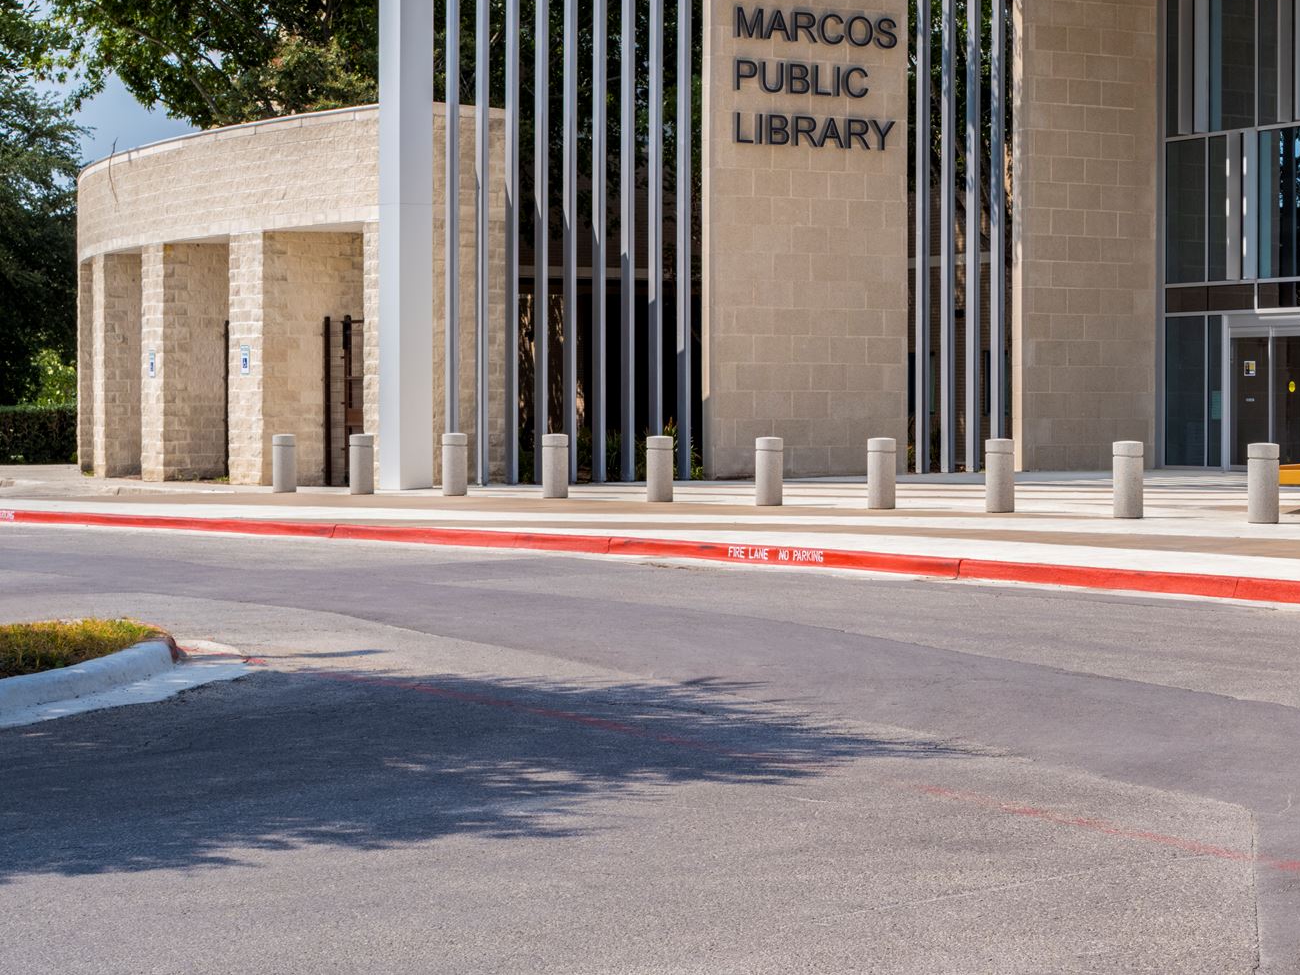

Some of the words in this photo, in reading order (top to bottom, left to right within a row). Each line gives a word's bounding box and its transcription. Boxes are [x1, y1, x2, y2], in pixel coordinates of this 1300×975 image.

[734, 6, 898, 49] MARCOS
[734, 59, 869, 99] PUBLIC
[733, 112, 897, 151] LIBRARY
[728, 546, 745, 558] FIRE
[748, 547, 769, 560] LANE
[778, 549, 790, 561] NO
[792, 550, 824, 562] PARKING
